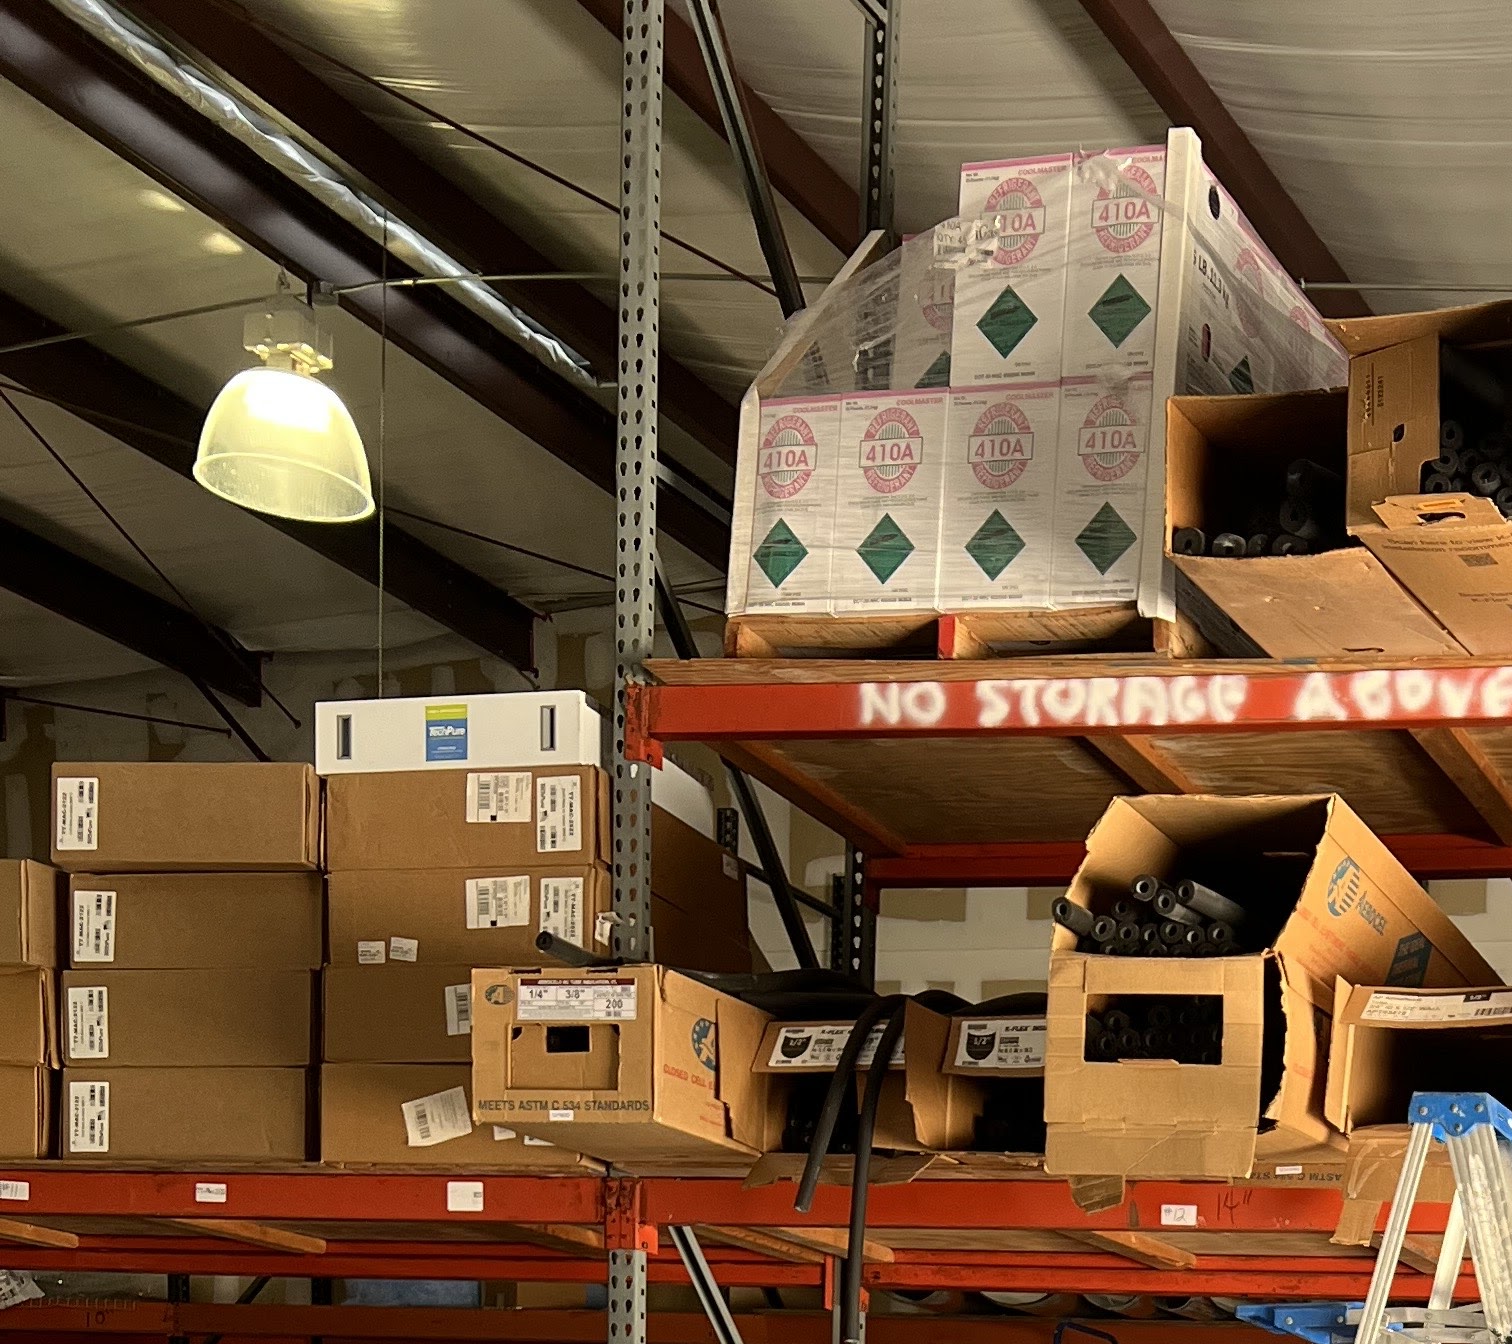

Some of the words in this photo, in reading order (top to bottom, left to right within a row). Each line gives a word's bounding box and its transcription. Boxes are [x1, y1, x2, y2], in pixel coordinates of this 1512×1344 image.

[1098, 199, 1151, 222] 410A
[974, 437, 1025, 458] 410A
[1084, 430, 1138, 450] 410A
[763, 449, 809, 470] 410A
[865, 442, 914, 463] 410A
[859, 680, 946, 728] NO
[977, 675, 1249, 728] STORAGE
[528, 988, 549, 999] 1/4"
[565, 988, 586, 999] 3/8"
[605, 999, 623, 1009] 200
[478, 1100, 515, 1111] MEETS
[518, 1100, 548, 1111] ASTM
[551, 1100, 561, 1111] C
[562, 1100, 581, 1111] 534
[584, 1100, 650, 1111] STANDARDS
